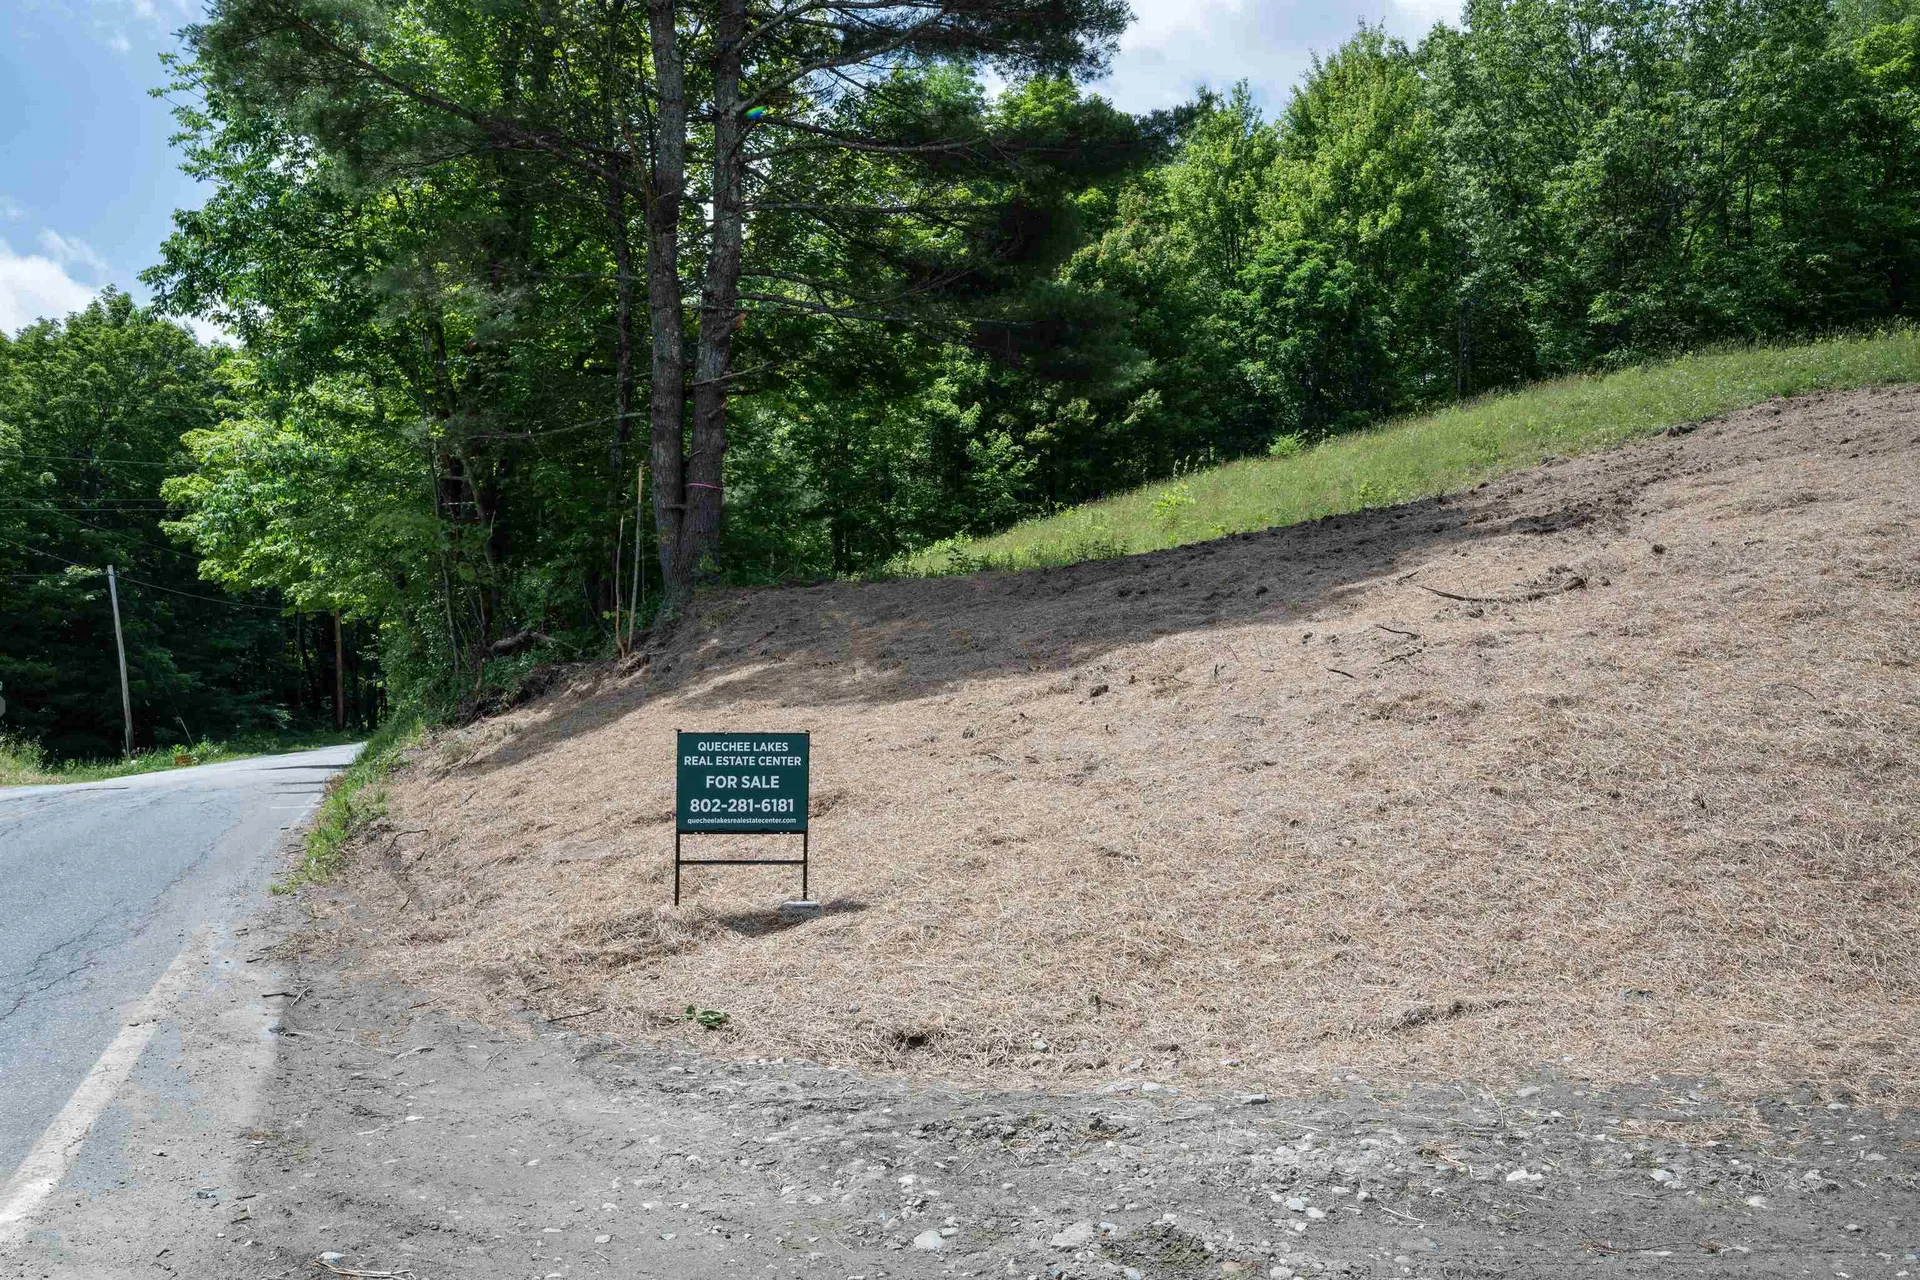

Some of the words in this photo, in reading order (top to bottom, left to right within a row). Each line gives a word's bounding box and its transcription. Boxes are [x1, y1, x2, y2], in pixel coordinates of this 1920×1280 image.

[698, 742, 750, 752] QUECHEE
[754, 742, 789, 751] LAKES
[684, 756, 712, 766] REAL
[716, 756, 755, 766] ESTATE
[758, 756, 801, 766] CENTER
[706, 776, 737, 788] FOR
[741, 776, 779, 788] SALE
[690, 799, 793, 812] 802-281-6181
